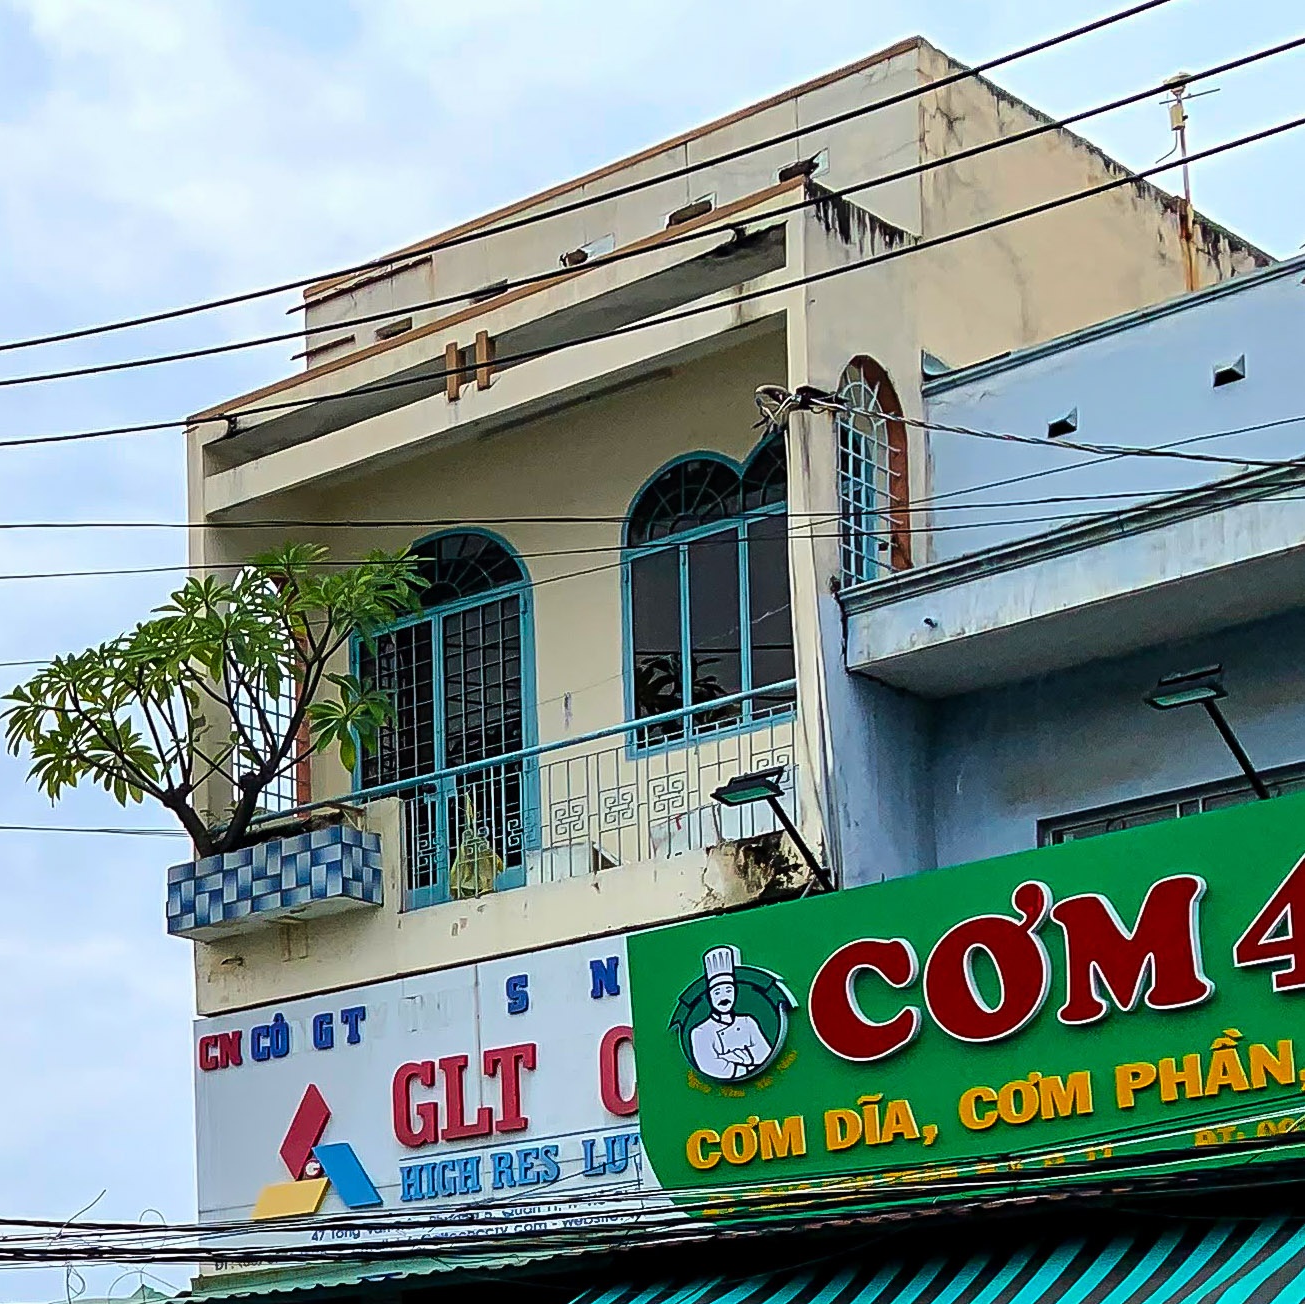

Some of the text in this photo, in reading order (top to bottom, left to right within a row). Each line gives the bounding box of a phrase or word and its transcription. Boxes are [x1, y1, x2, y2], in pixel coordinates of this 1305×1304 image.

[808, 872, 1216, 1064] CƠM
[198, 1030, 242, 1071] CN
[392, 1042, 537, 1149] GLT
[685, 1113, 808, 1170] CƠM
[825, 1093, 939, 1152] DĨA,
[958, 1070, 1094, 1131] CƠM
[400, 1154, 481, 1203] HIGH
[490, 1143, 560, 1190] RES
